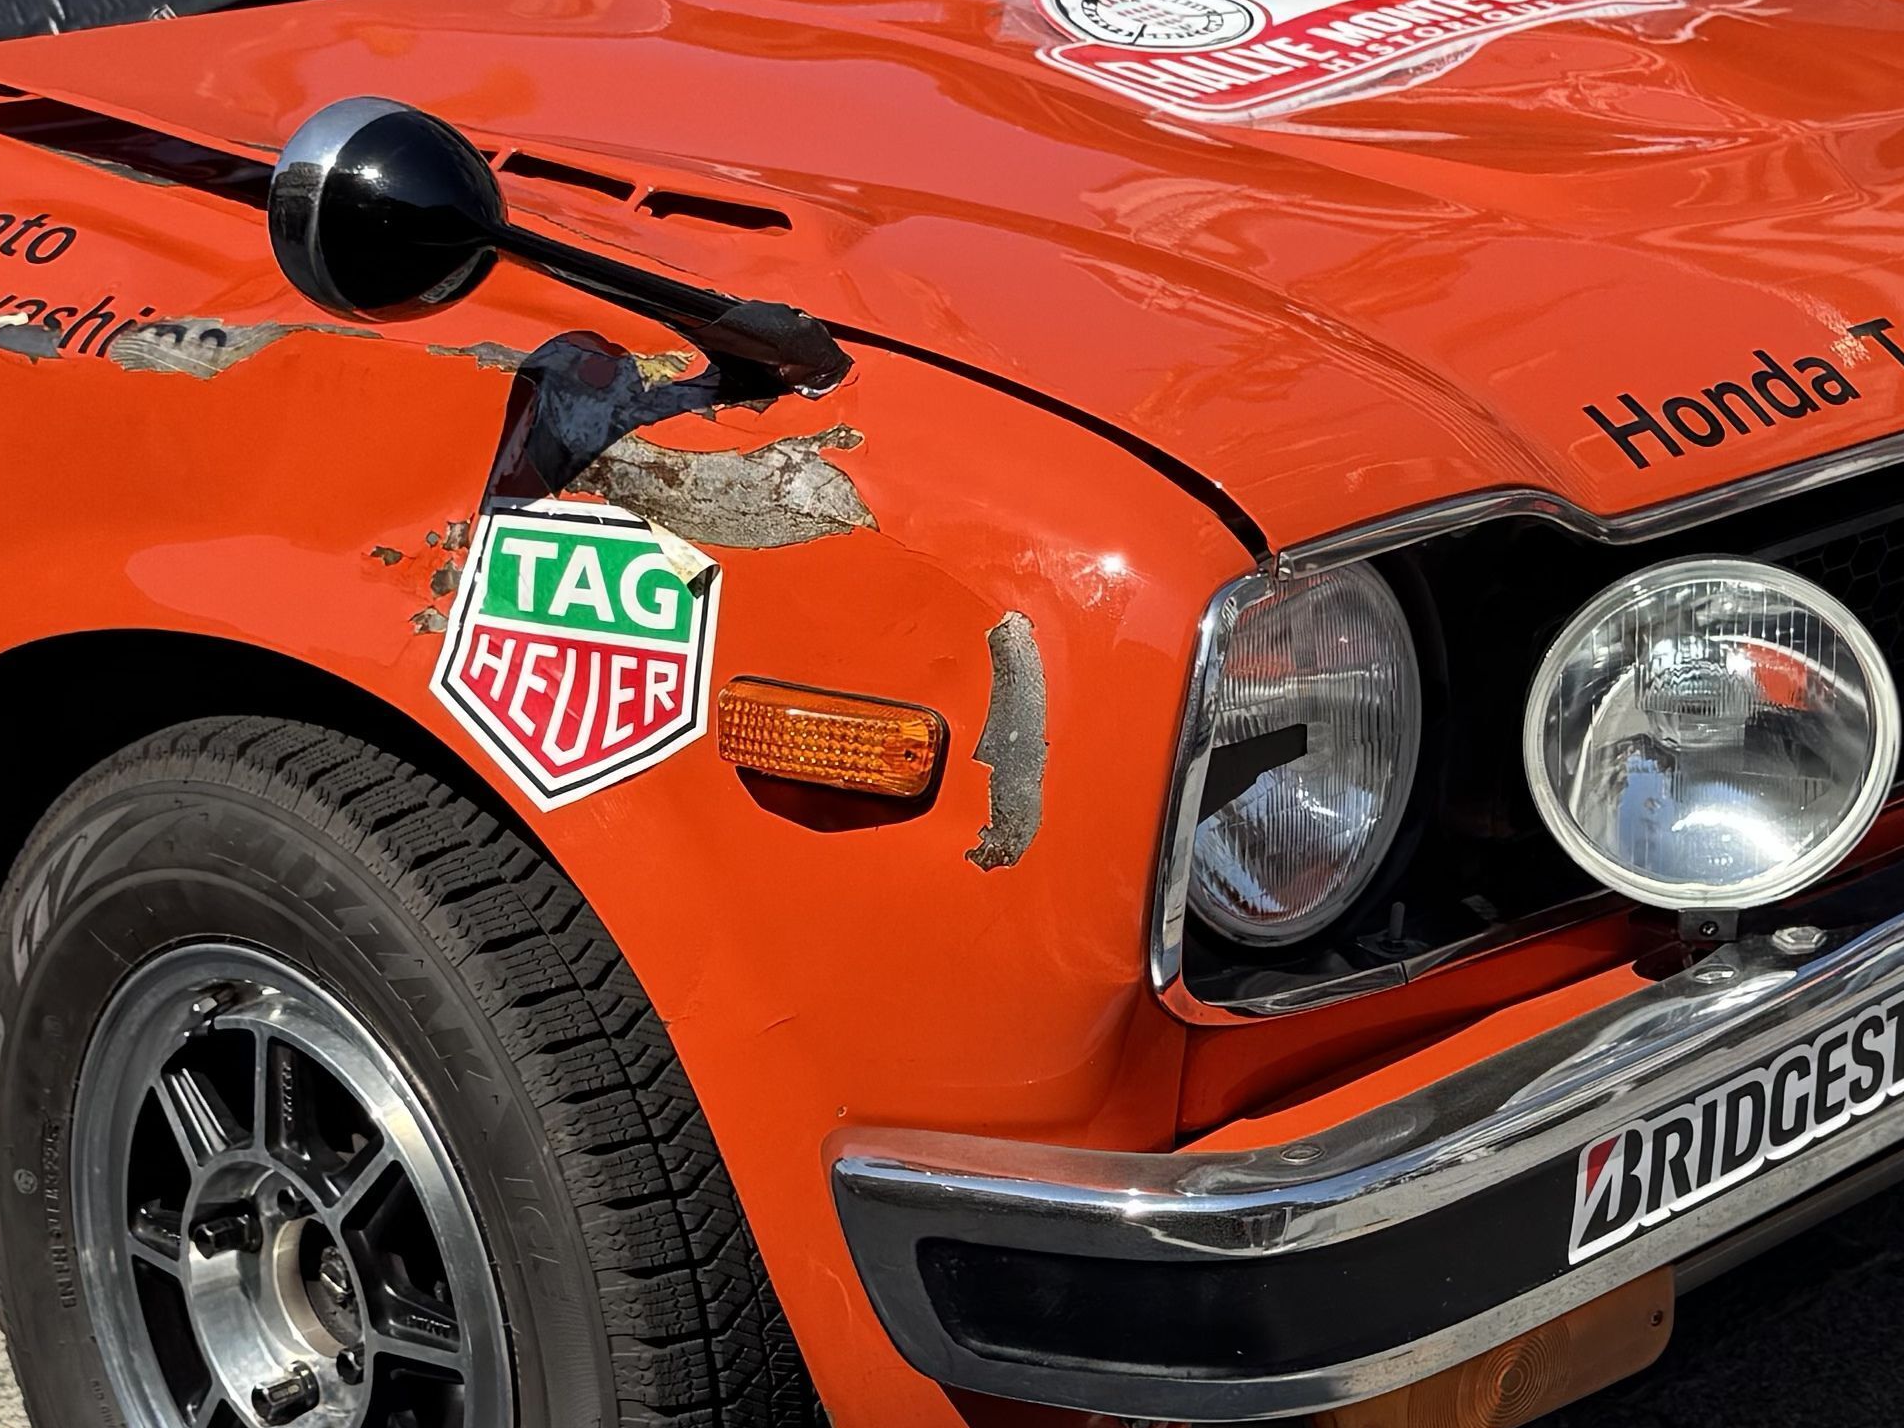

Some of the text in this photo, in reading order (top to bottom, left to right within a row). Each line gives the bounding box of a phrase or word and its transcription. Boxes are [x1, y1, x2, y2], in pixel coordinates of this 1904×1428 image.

[1096, 37, 1336, 99] RALLYE
[1318, 1, 1560, 73] HISTORIQUE
[1581, 349, 1860, 470] Honda
[500, 537, 680, 630] TAG
[469, 633, 679, 767] HEUER
